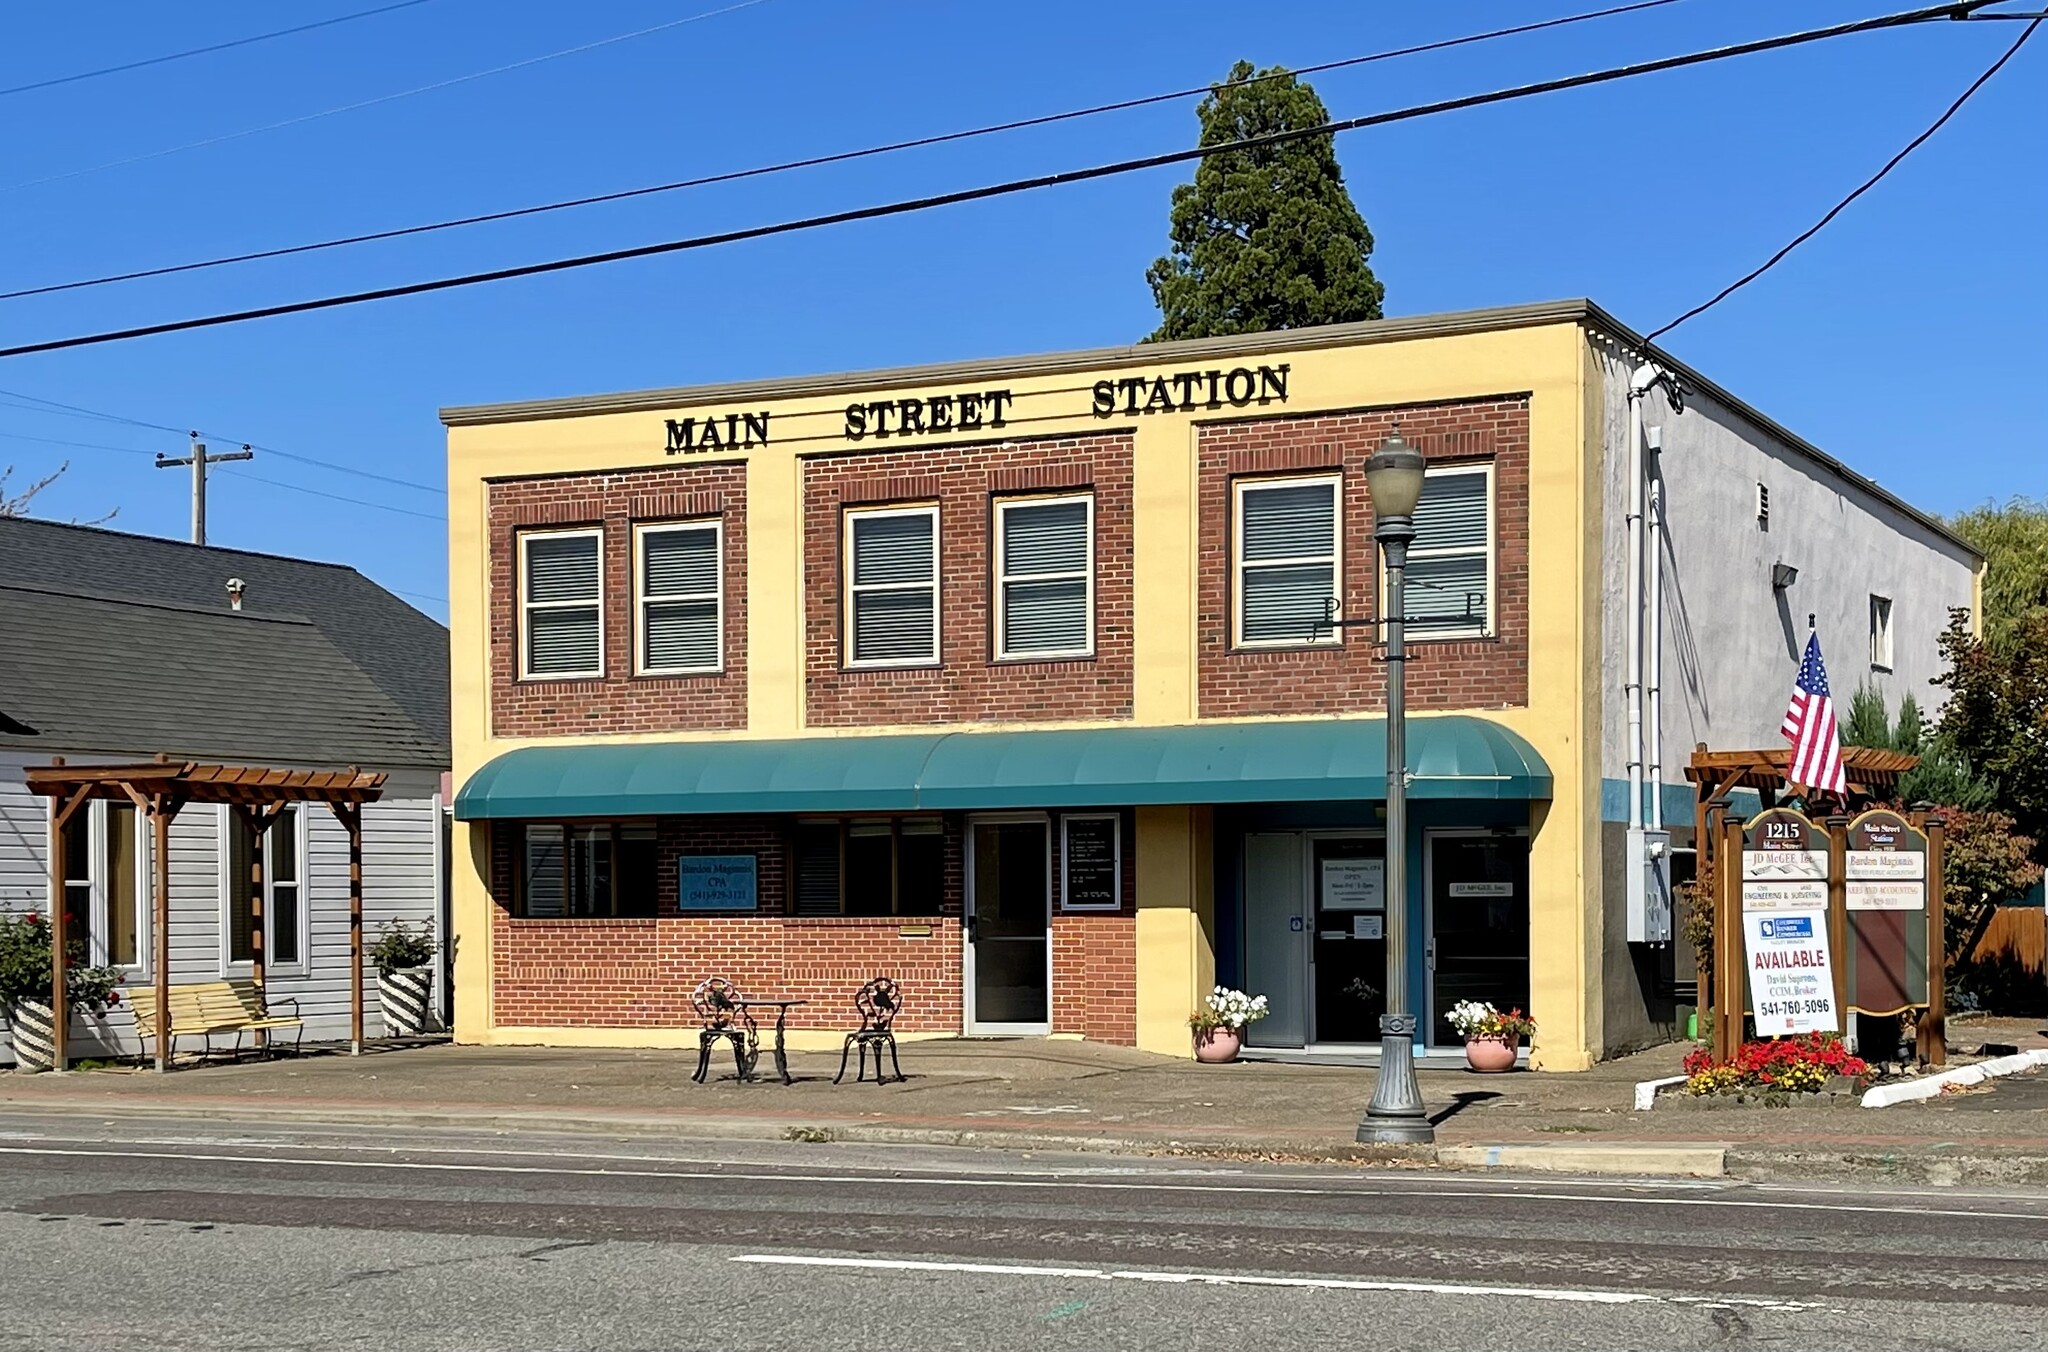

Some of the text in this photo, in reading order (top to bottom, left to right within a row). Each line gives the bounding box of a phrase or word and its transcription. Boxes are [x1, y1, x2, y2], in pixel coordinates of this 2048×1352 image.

[665, 364, 1291, 454] MAIN STREET STATION
[1766, 822, 1800, 838] 1215
[1863, 823, 1900, 833] Main Street
[1870, 833, 1894, 843] Station
[1763, 841, 1803, 850] Main Street
[1753, 853, 1764, 865] JD
[707, 877, 727, 888] CPA
[1755, 949, 1825, 970] AVAILABLE
[1766, 973, 1787, 984] David
[1794, 985, 1817, 996] Broker
[1761, 999, 1830, 1016] 541-760-5096
